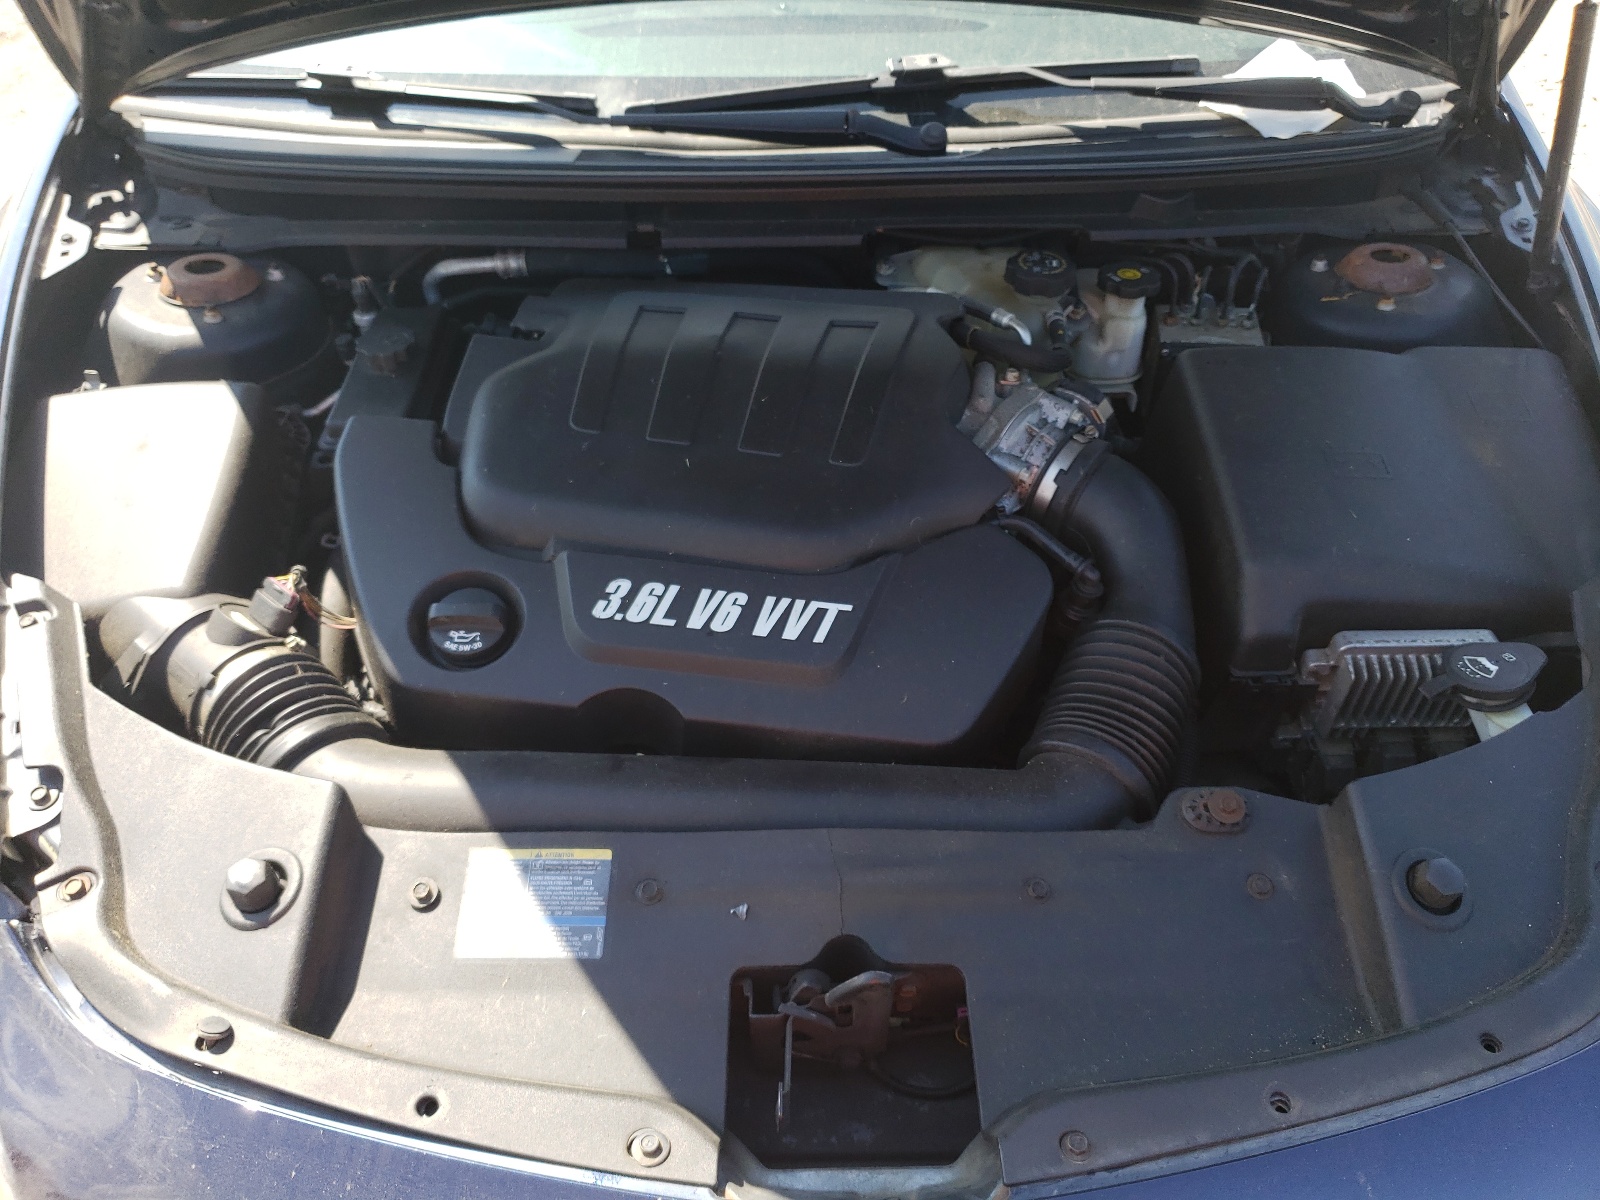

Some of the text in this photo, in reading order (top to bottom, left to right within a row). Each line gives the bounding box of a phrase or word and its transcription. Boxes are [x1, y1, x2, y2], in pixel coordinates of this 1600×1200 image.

[591, 578, 853, 643] 3.6L V6 VVT
[444, 641, 482, 651] SAE 5W-30
